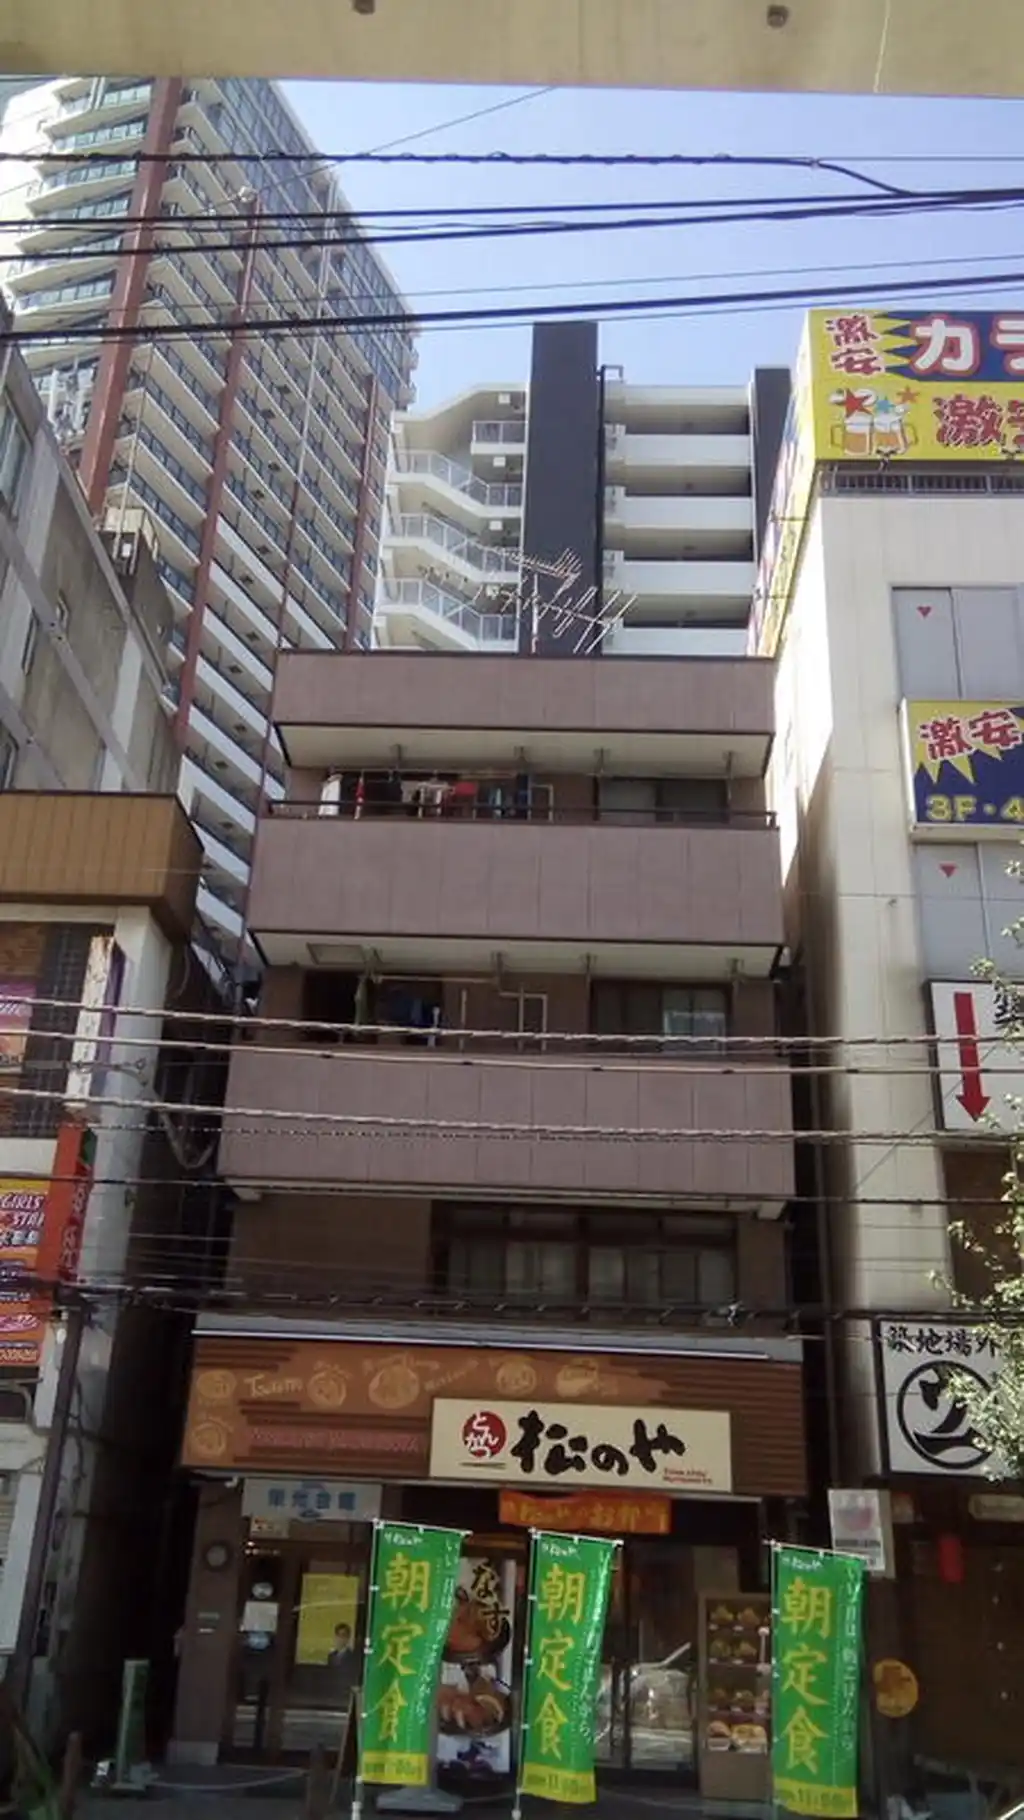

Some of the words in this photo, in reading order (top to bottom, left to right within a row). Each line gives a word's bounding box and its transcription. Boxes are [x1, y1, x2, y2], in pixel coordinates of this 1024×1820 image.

[826, 313, 885, 375] 激安
[919, 710, 1022, 761] 激安
[510, 1409, 686, 1476] 松のや
[375, 1551, 431, 1744] 朝定食
[534, 1563, 588, 1760] 朝定食
[780, 1576, 833, 1775] 朝定食
